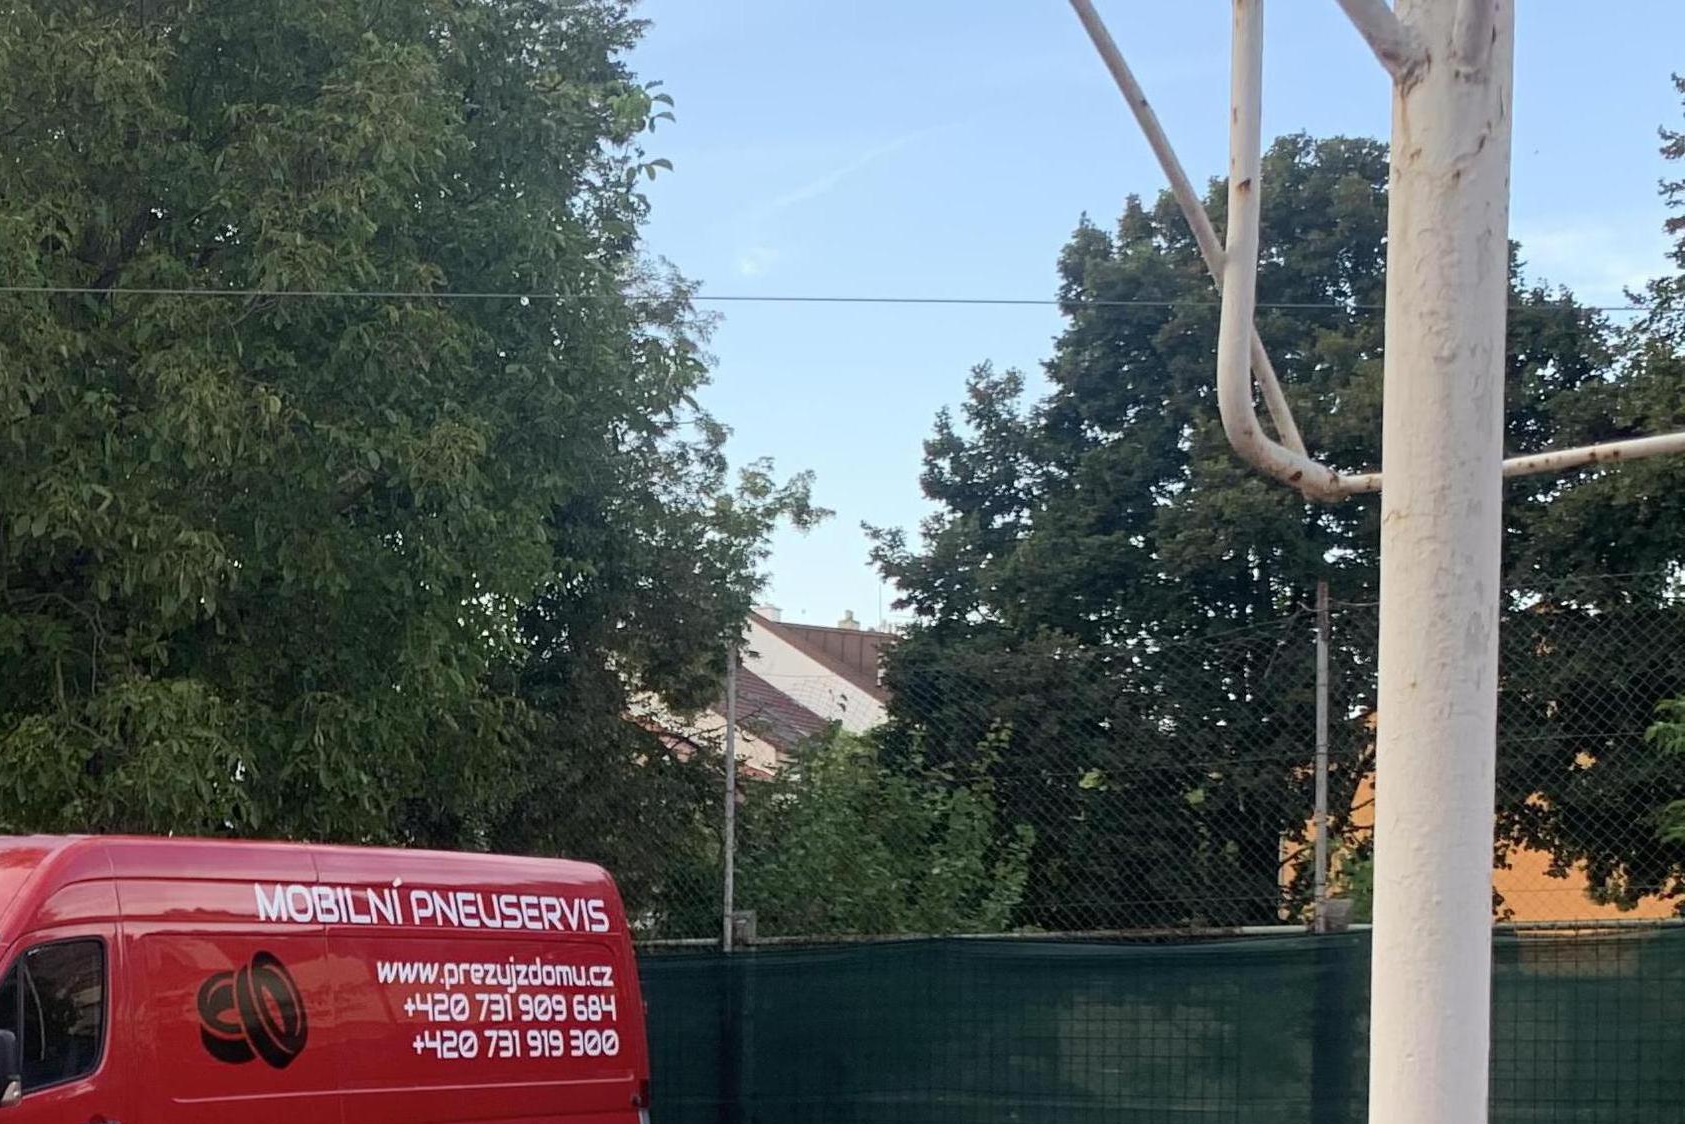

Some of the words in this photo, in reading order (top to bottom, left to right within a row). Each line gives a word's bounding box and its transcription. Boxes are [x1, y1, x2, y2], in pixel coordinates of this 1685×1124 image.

[254, 877, 403, 925] MOBILNÍ
[410, 890, 609, 932] PNEUSERVIS
[377, 957, 613, 992] www.prezujzdomu.cz
[404, 993, 469, 1021] +420
[475, 993, 513, 1021] 731
[518, 993, 566, 1021] 909
[573, 994, 616, 1021] 684
[413, 1030, 478, 1058] +420
[484, 1030, 521, 1058] 731
[527, 1030, 563, 1057] 919
[570, 1030, 619, 1057] 300
